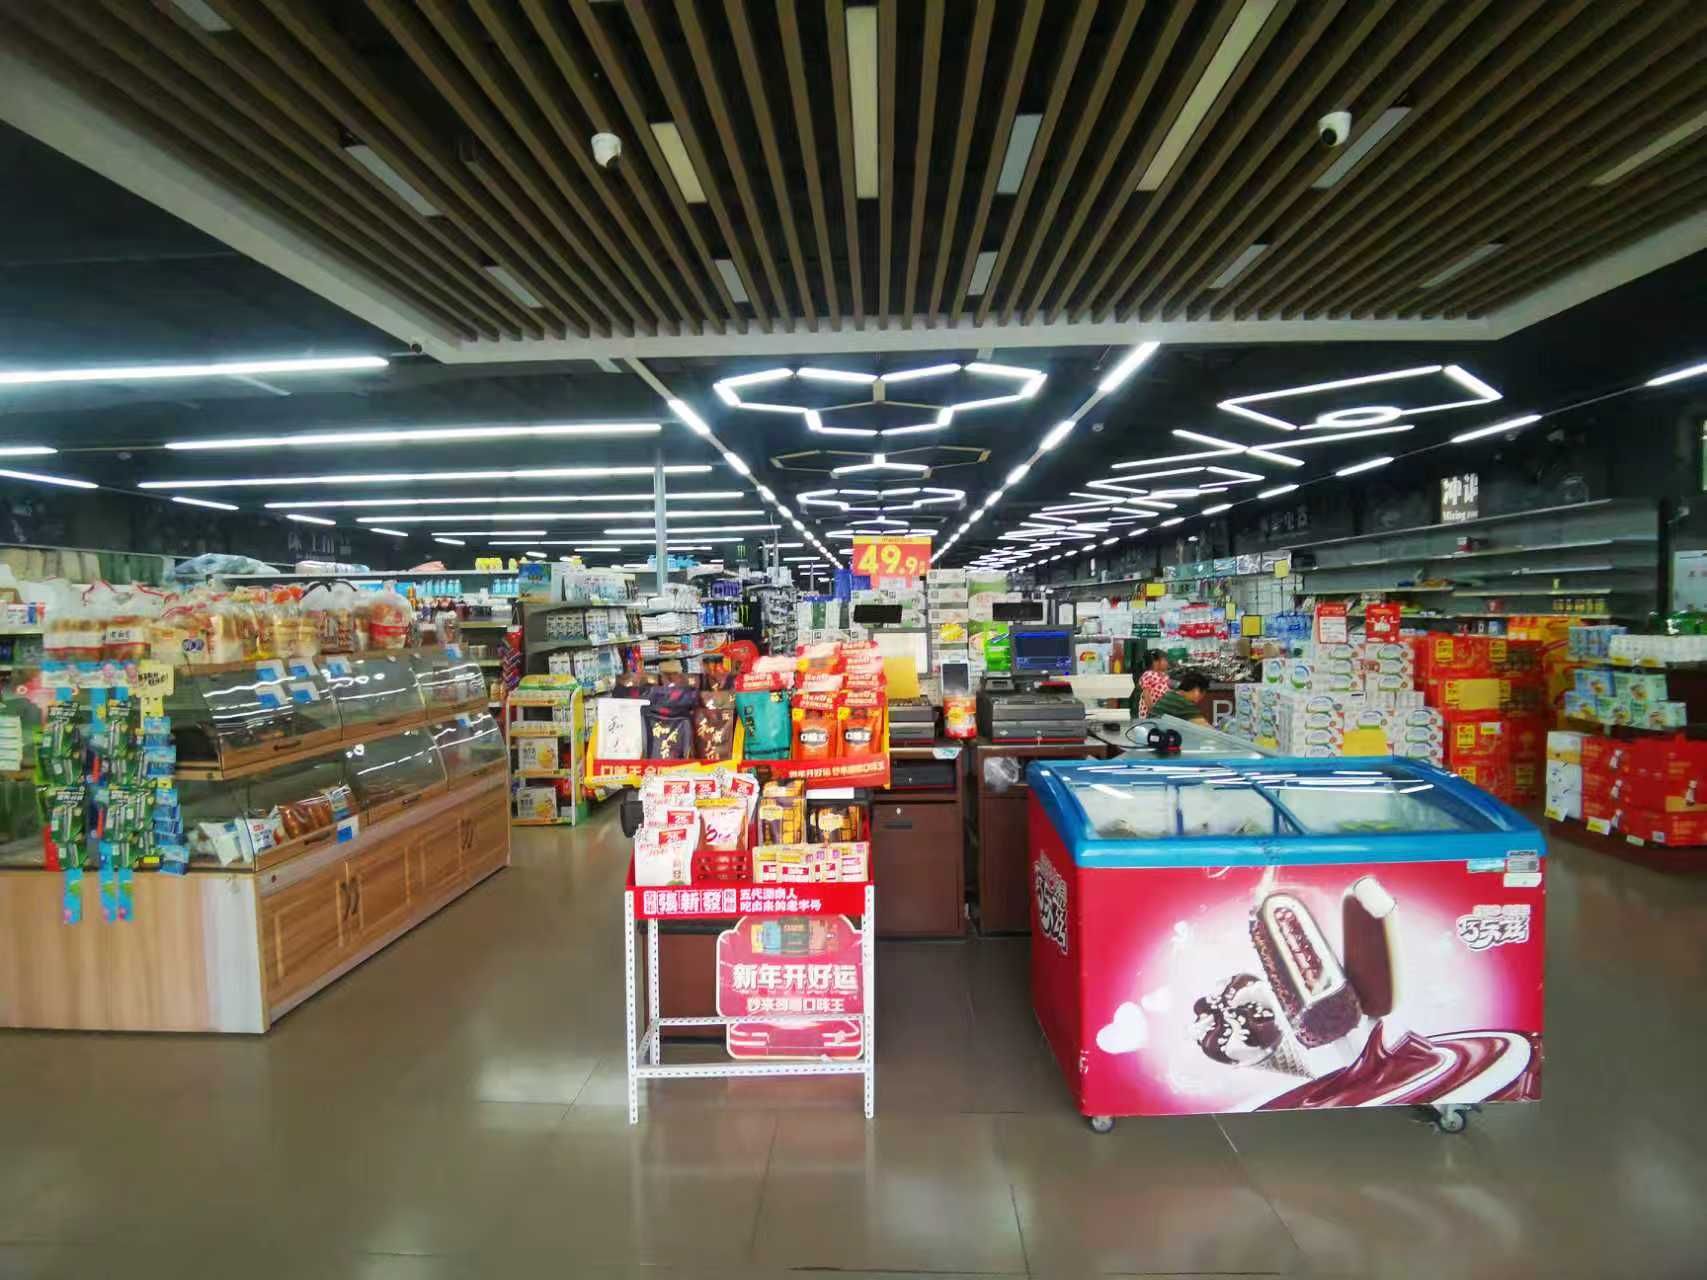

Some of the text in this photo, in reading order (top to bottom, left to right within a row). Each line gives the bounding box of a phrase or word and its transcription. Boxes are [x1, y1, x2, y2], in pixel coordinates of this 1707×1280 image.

[857, 544, 919, 576] 49.9
[733, 963, 859, 991] 新年开好运
